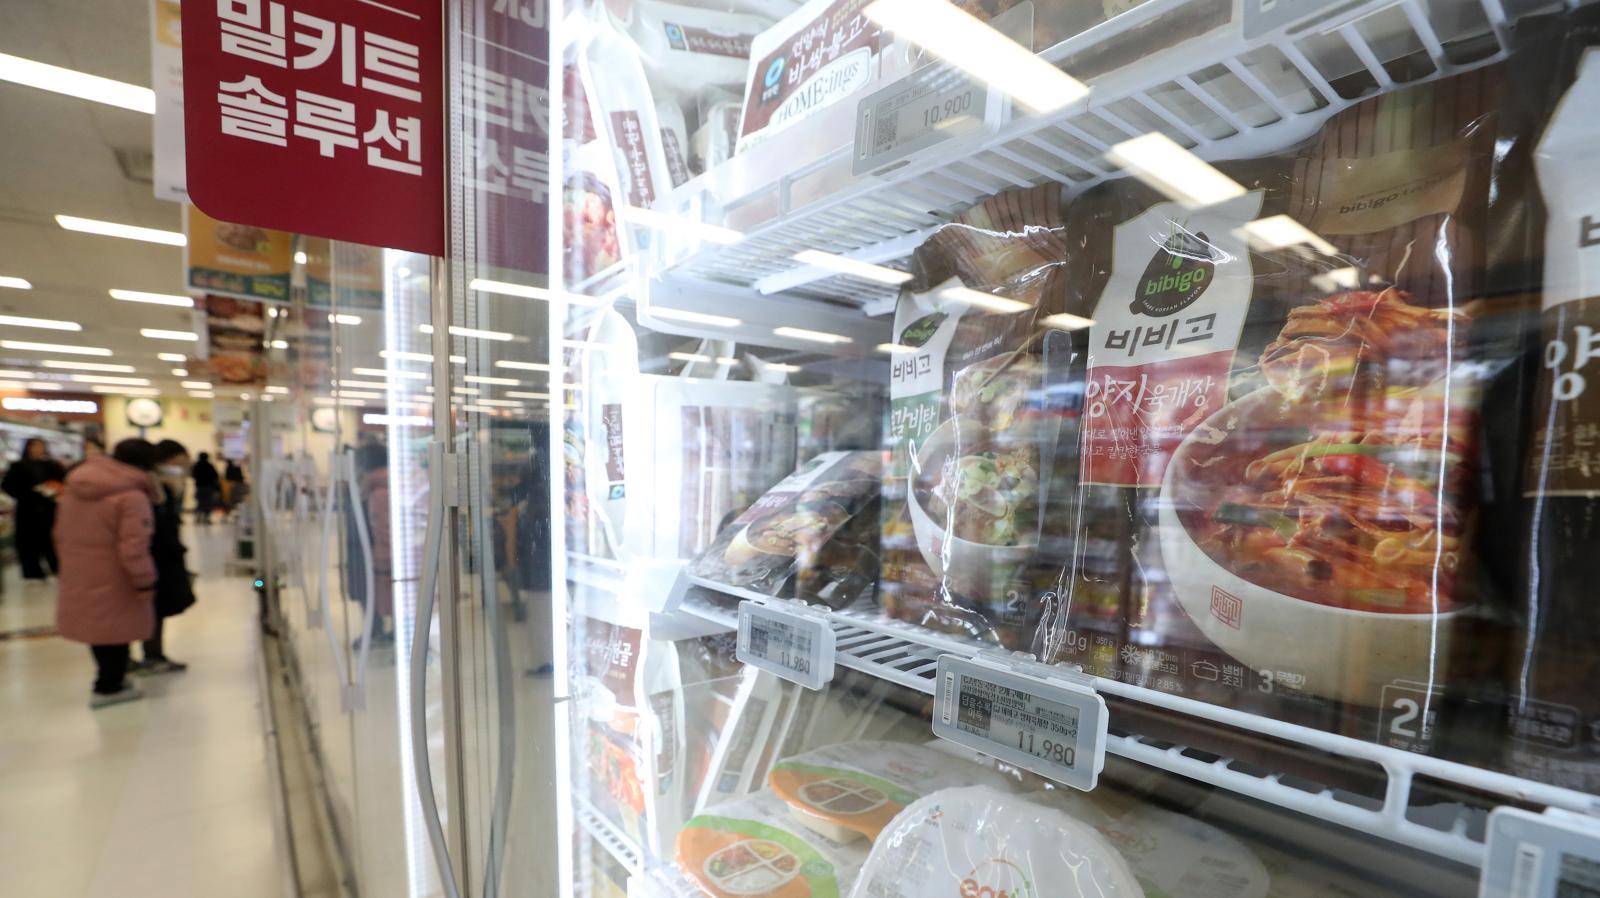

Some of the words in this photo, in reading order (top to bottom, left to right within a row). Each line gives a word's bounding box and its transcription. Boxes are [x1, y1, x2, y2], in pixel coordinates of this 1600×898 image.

[217, 0, 422, 103] 밀키트
[217, 74, 422, 176] 솔루션
[1339, 192, 1398, 215] bibigo
[1144, 265, 1206, 297] bibigo
[1104, 313, 1217, 357] 비비고
[892, 353, 931, 383] 비비고
[780, 651, 811, 675] 11,980
[1222, 663, 1243, 677] 냄비
[1222, 675, 1243, 689] 조리
[1258, 669, 1274, 694] 3
[1391, 697, 1419, 737] 2
[1017, 730, 1076, 767] 11,980
